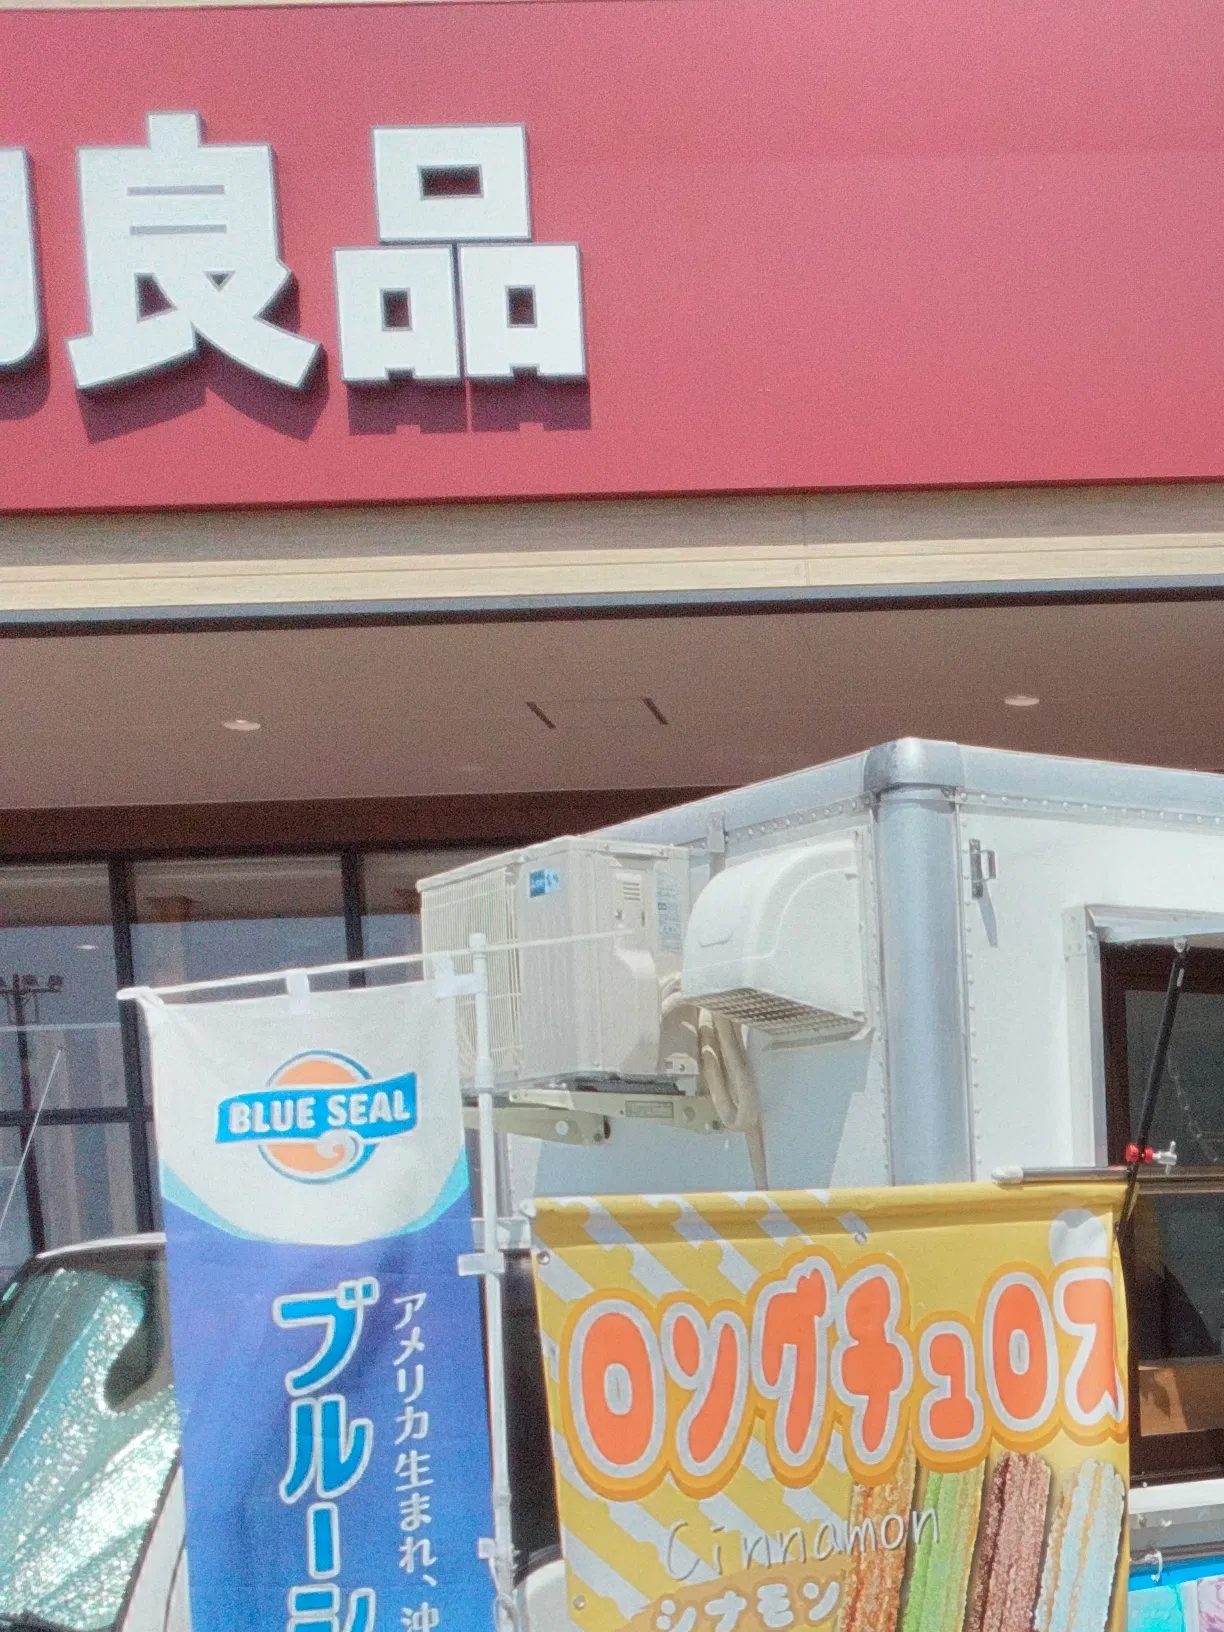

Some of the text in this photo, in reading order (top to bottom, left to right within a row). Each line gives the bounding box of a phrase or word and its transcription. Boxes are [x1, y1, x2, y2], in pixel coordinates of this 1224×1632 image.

[0, 110, 588, 390] 良品
[229, 1088, 411, 1134] BLUE SEAL
[566, 1254, 1126, 1480] ロングチュロス
[665, 1506, 941, 1581] Cinnamon
